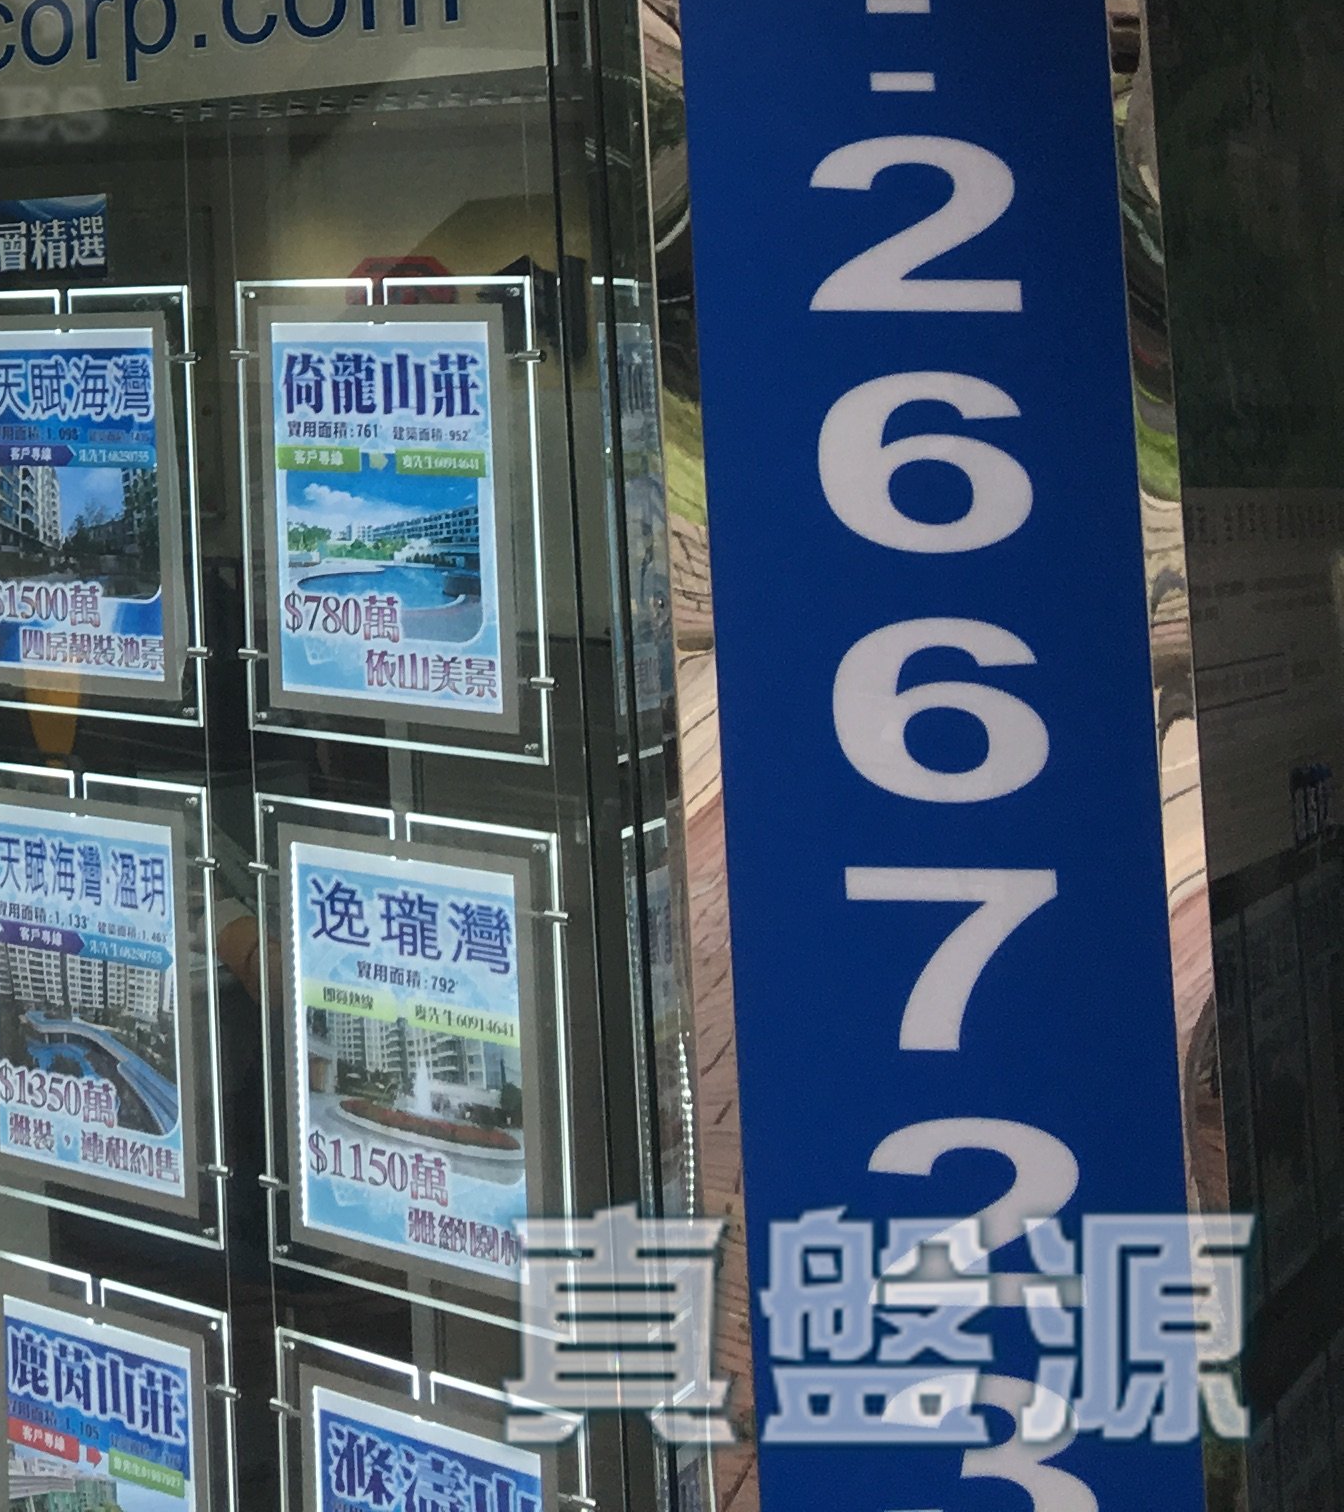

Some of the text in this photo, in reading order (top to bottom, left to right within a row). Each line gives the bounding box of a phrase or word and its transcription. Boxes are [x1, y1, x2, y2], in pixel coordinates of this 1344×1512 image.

[281, 352, 481, 418] 倚龍山莊
[283, 589, 401, 644] $780萬
[364, 647, 498, 700] 依山美景
[309, 877, 513, 975] 逸瓏灣
[307, 1129, 449, 1208] $1150萬
[9, 1330, 181, 1441] 鹿茵山莊
